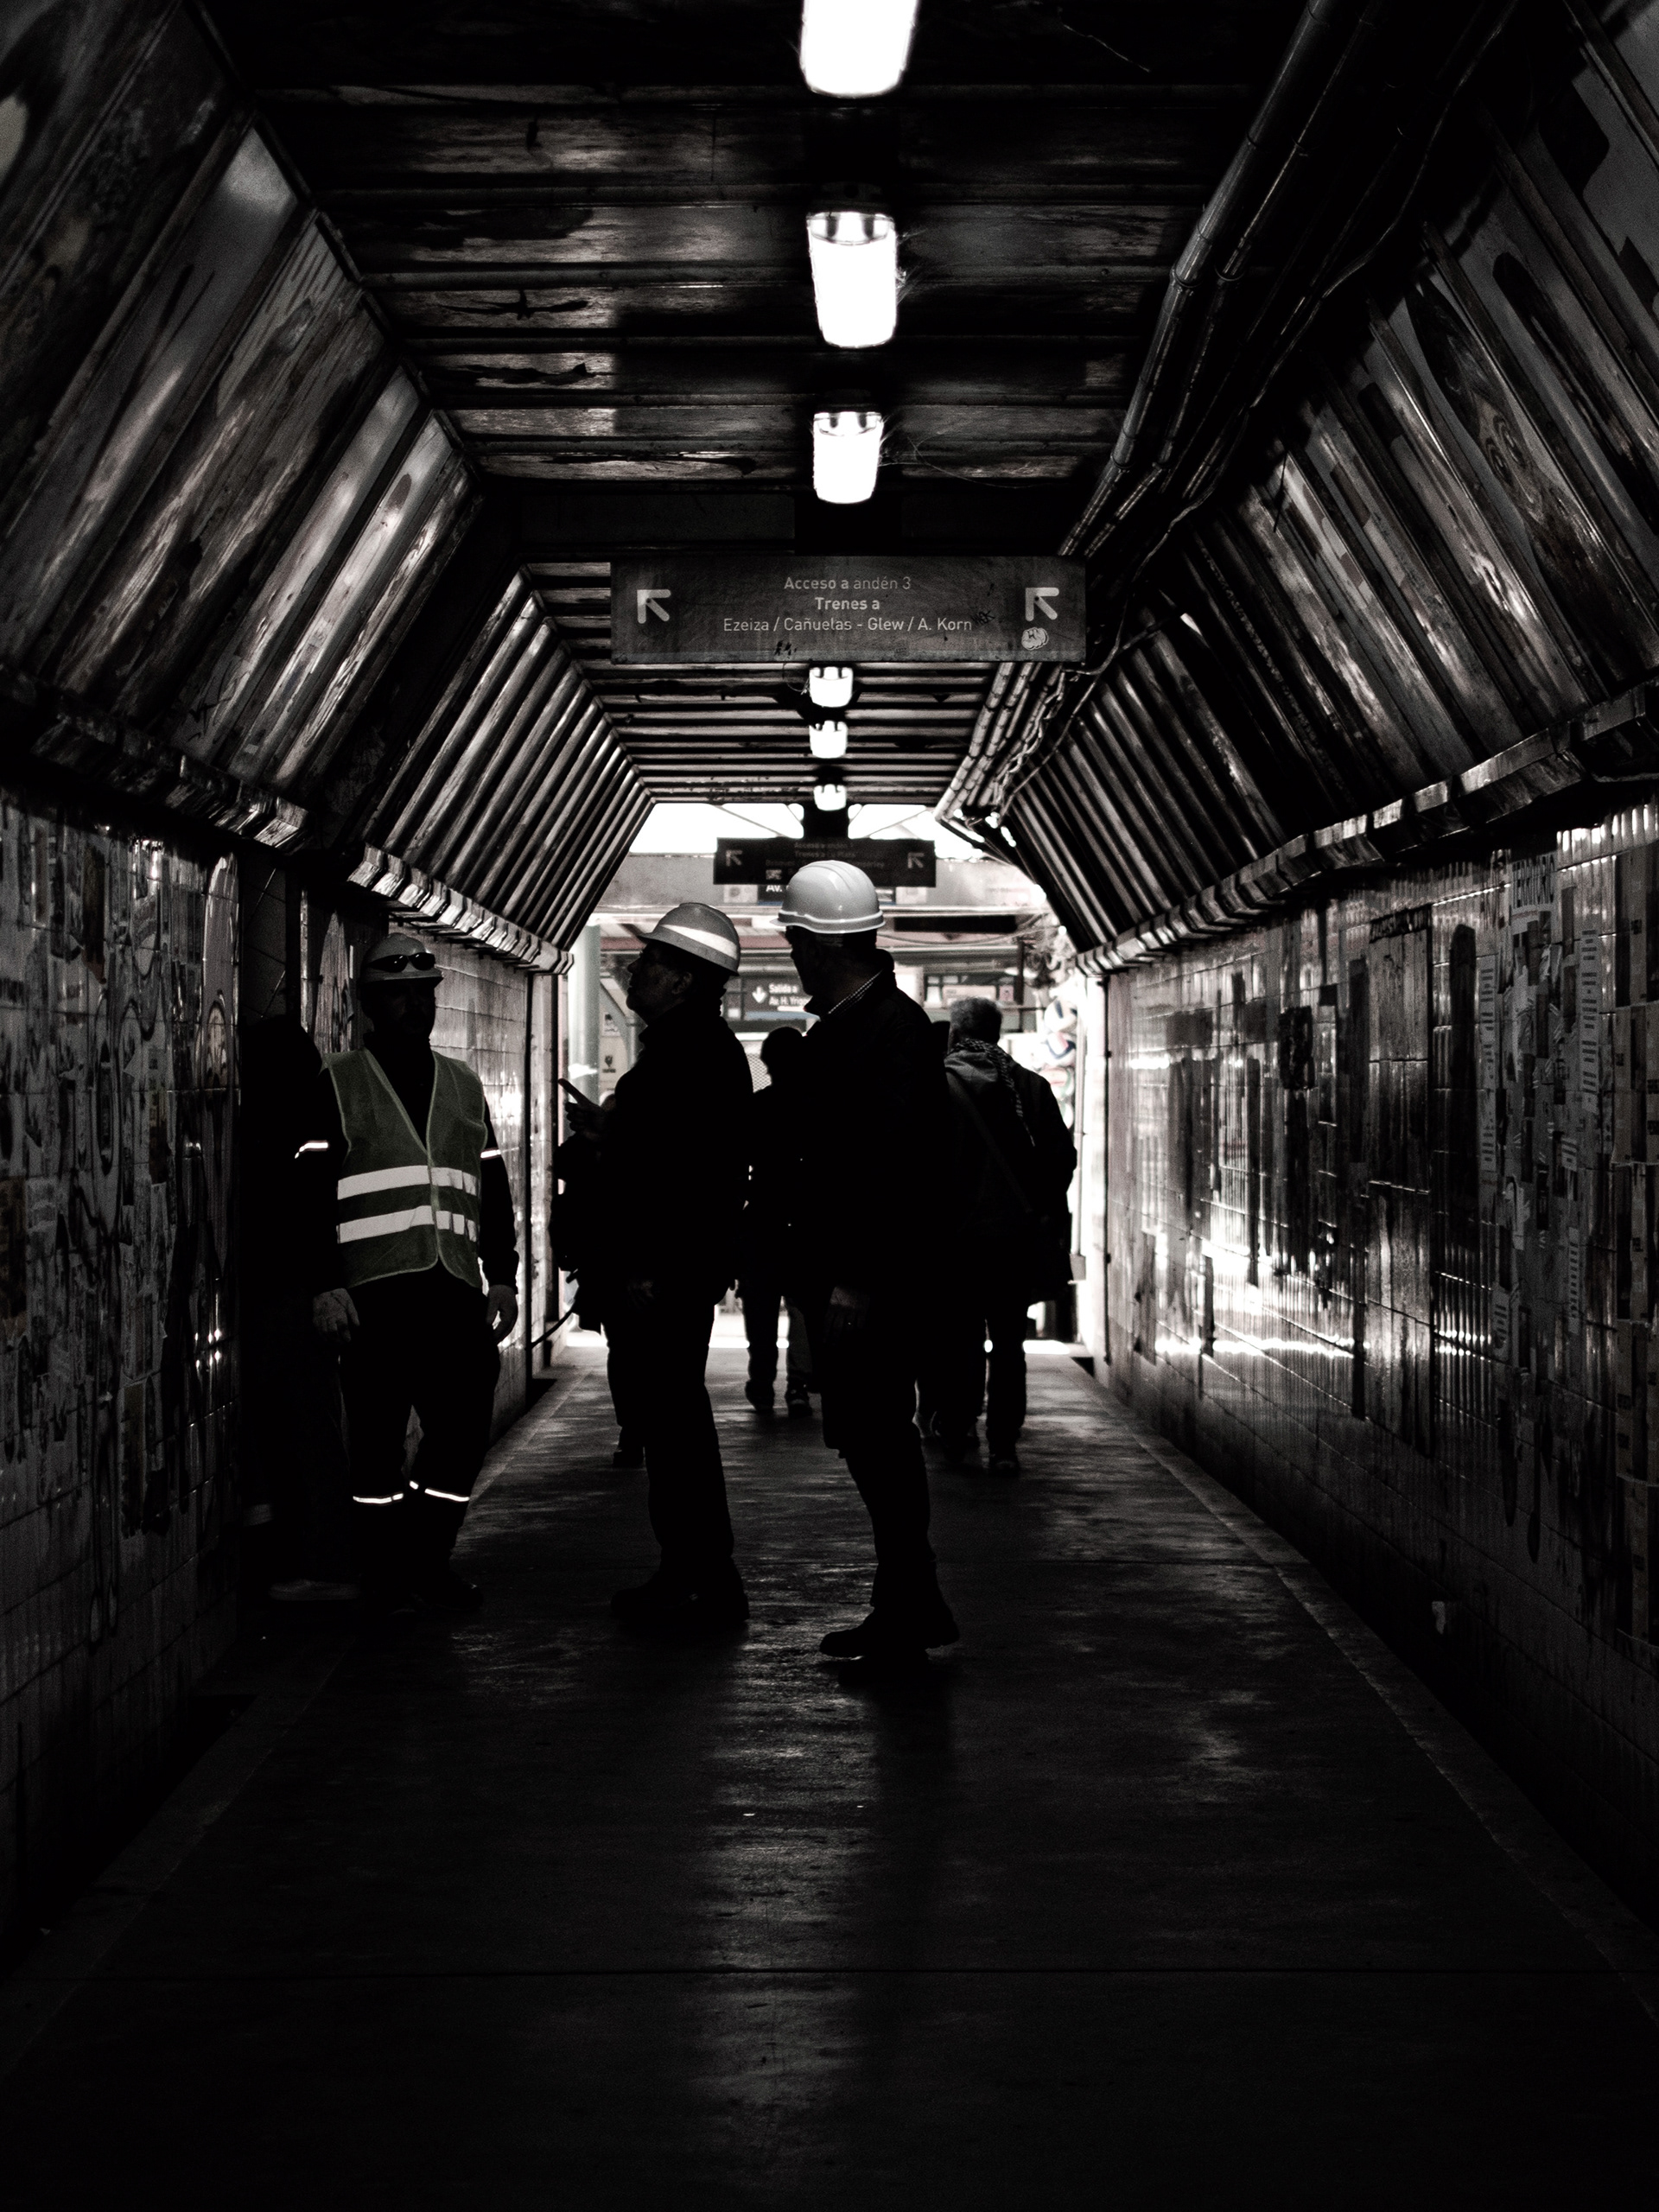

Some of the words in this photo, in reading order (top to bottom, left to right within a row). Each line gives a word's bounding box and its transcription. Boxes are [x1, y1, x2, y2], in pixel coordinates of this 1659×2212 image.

[784, 576, 837, 590] Acceso
[841, 579, 849, 590] a
[853, 575, 898, 590] andén
[903, 576, 912, 590] 3
[814, 596, 868, 611] Trenes
[872, 599, 880, 611] a
[723, 617, 770, 632] Ezeiza
[784, 616, 853, 632] Cañuelas
[868, 617, 905, 632] Glew
[918, 617, 932, 631] A.
[937, 617, 972, 631] Korn
[768, 983, 791, 994] Salida
[791, 985, 798, 994] a
